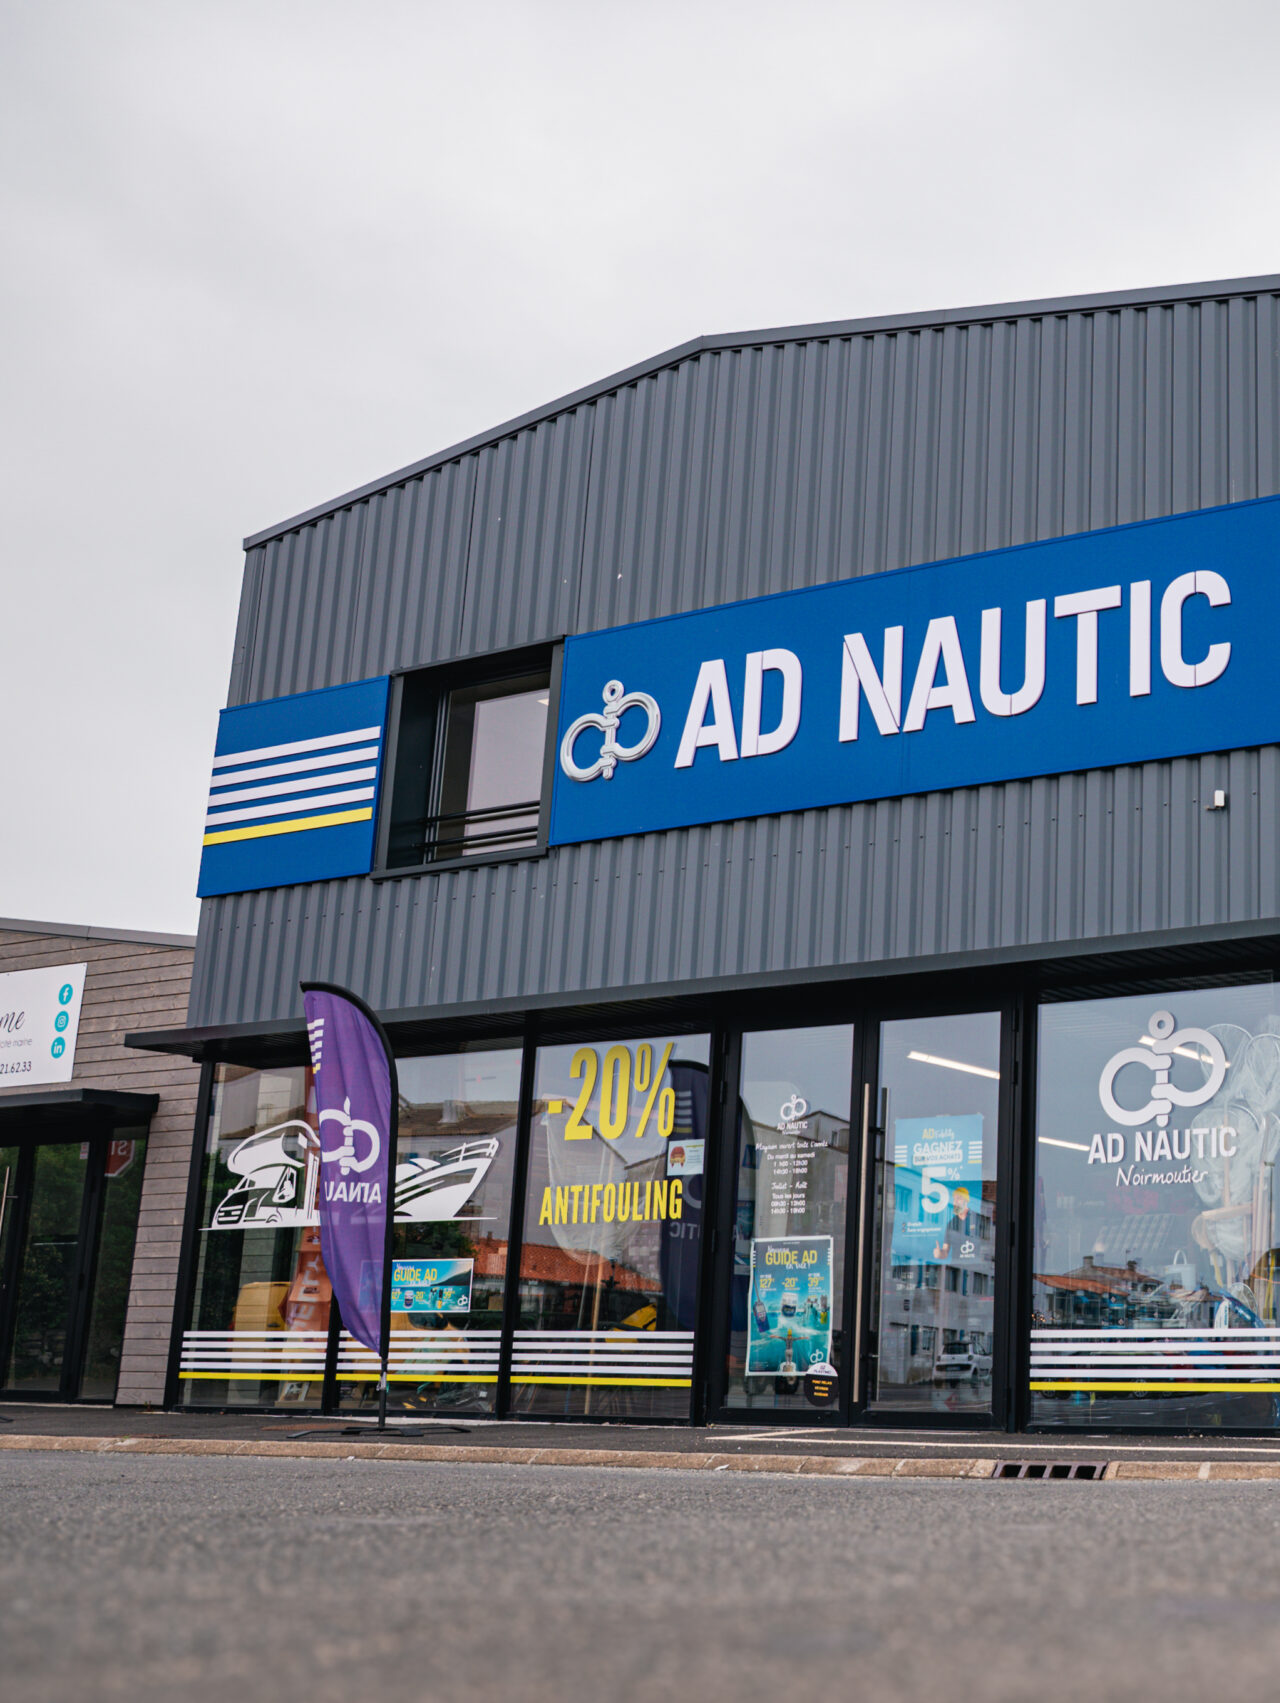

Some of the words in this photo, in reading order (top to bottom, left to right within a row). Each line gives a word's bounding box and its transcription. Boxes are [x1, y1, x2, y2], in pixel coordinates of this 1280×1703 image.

[673, 647, 803, 770] AD
[838, 568, 1233, 743] NAUTIC
[548, 1042, 676, 1141] -20%
[786, 1121, 808, 1129] NAUTIC
[913, 1141, 963, 1154] GAGNEZ
[1087, 1132, 1125, 1164] AD
[1134, 1127, 1237, 1162] NAUTIC
[1116, 1164, 1209, 1187] Noirmoutier
[539, 1178, 683, 1226] ANTIFOULING
[765, 1250, 799, 1265] GUIDE
[802, 1250, 818, 1265] AD
[394, 1268, 421, 1282] GUIDE
[424, 1268, 438, 1281] AD
